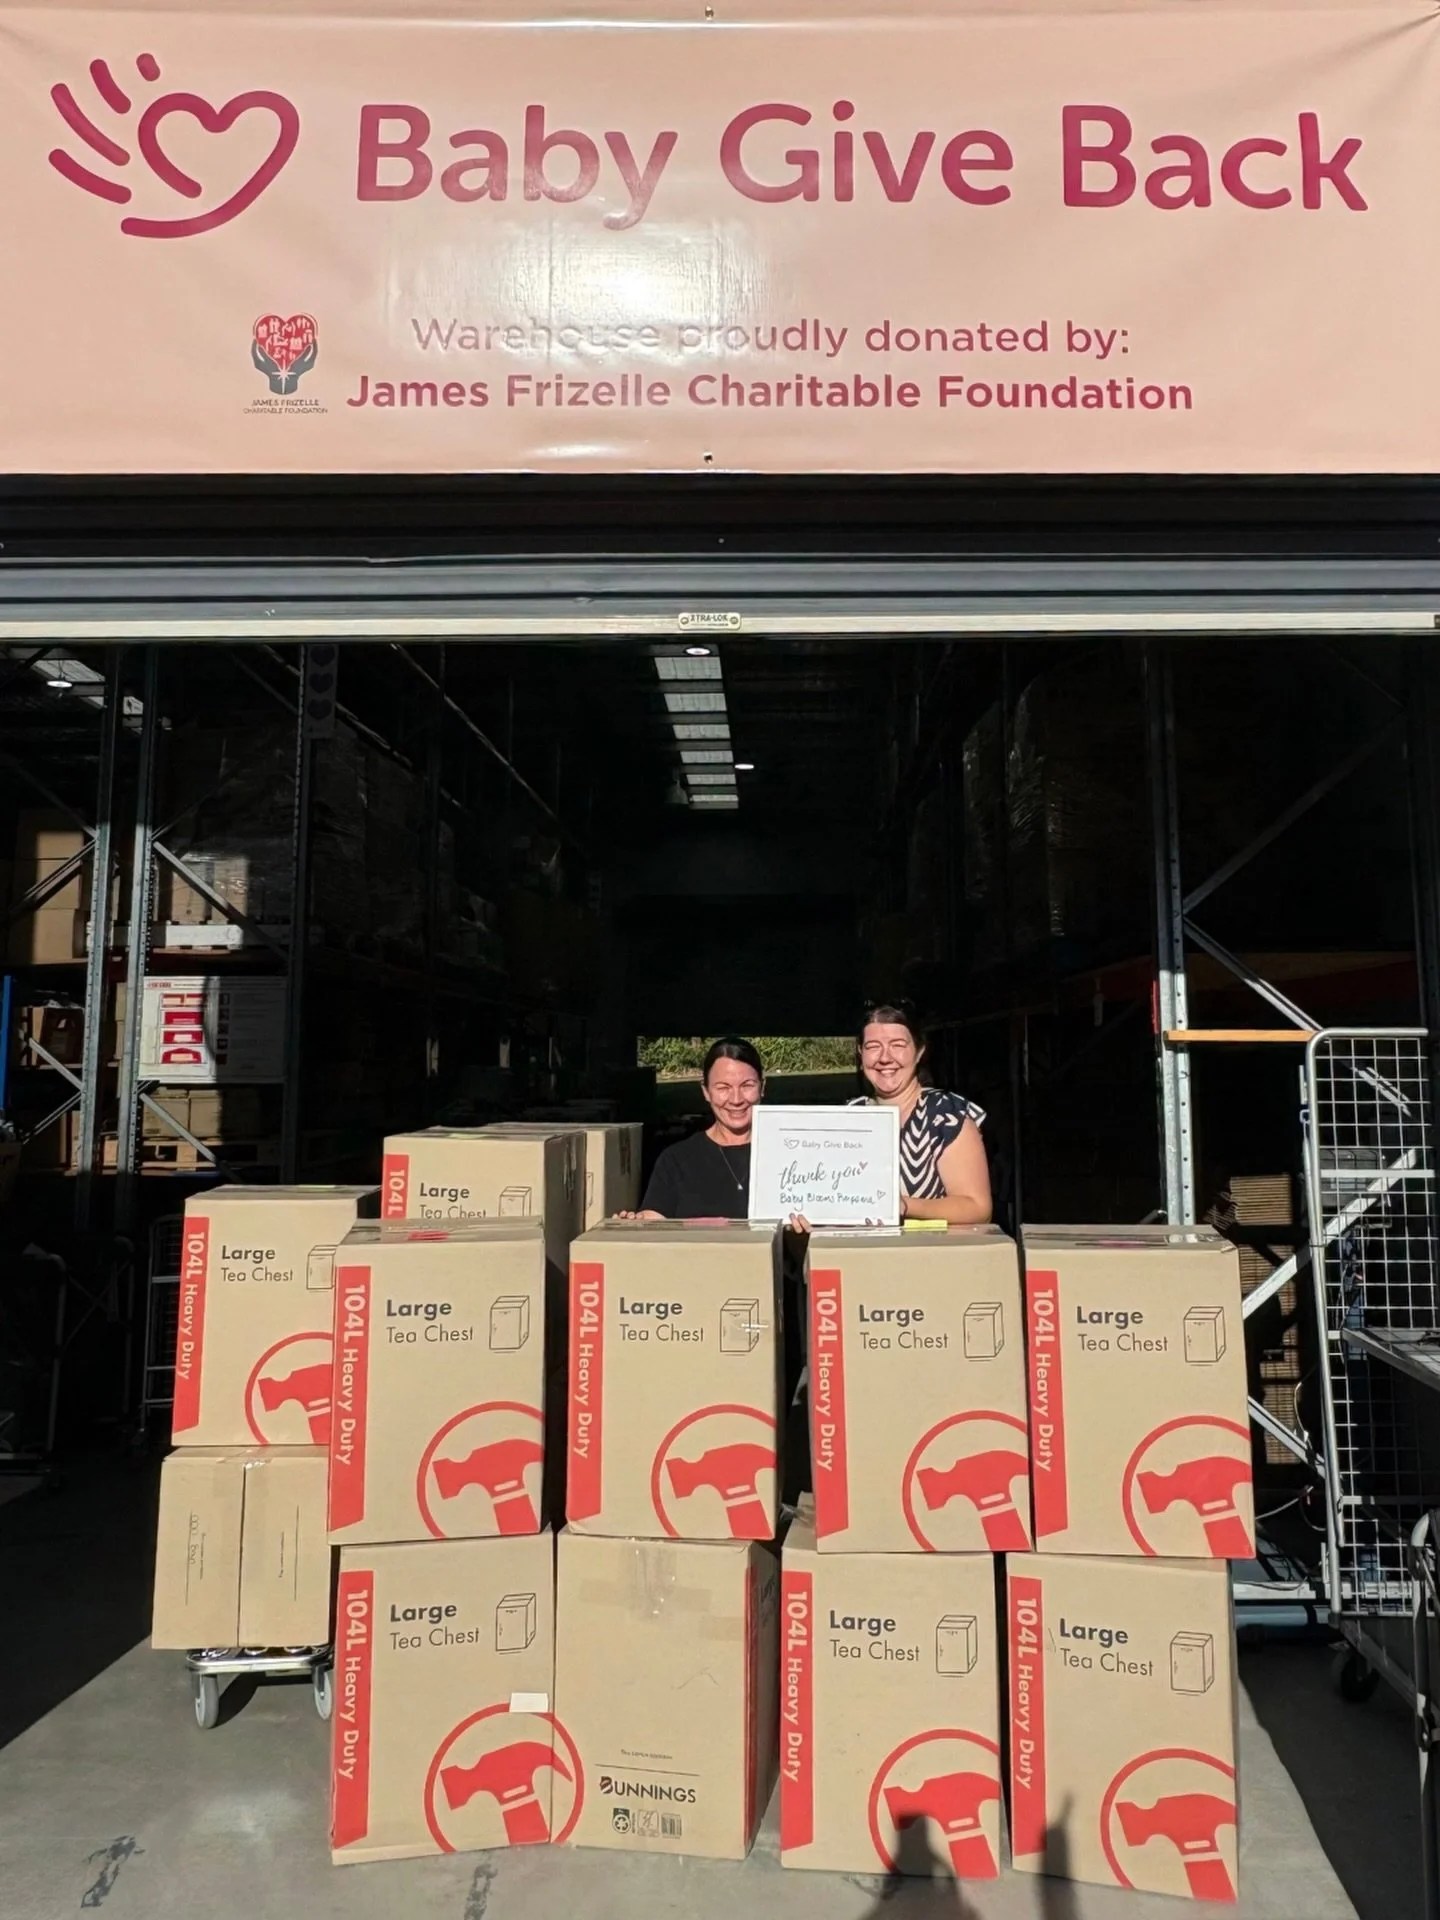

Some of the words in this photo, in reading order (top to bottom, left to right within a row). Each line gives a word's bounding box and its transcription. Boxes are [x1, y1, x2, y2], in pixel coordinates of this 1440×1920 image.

[357, 104, 678, 231] Baby
[720, 100, 1014, 205] Give
[1062, 104, 1368, 211] Back
[411, 317, 661, 351] Warehouse
[678, 318, 848, 358] proudly
[865, 319, 1048, 354] donated
[1065, 320, 1130, 360] by:
[347, 374, 489, 408] James
[506, 373, 671, 408] Frizelle
[688, 373, 921, 408] Charitable
[938, 374, 1193, 410] Foundation
[387, 1169, 405, 1216] 104L
[420, 1182, 470, 1202] Large
[778, 1160, 827, 1190] thank
[831, 1166, 862, 1190] you
[419, 1204, 442, 1219] Tea
[779, 1191, 804, 1212] Baby
[186, 1232, 205, 1279] 104L
[221, 1245, 276, 1264] Large
[221, 1267, 247, 1282] Tea
[251, 1266, 294, 1282] Chest
[180, 1284, 198, 1336] Heavy
[343, 1284, 366, 1343] 104L
[386, 1299, 452, 1321] Large
[579, 1281, 599, 1338] 104L
[619, 1297, 683, 1319] Large
[816, 1288, 838, 1347] 104L
[859, 1304, 924, 1327] Large
[1033, 1289, 1055, 1347] 104L
[1076, 1306, 1144, 1329] Large
[386, 1326, 417, 1343] Tea
[424, 1324, 473, 1343] Chest
[619, 1323, 649, 1341] Tea
[656, 1323, 704, 1342] Chest
[859, 1331, 891, 1349] Tea
[898, 1330, 949, 1349] Chest
[1077, 1333, 1110, 1351] Tea
[1116, 1332, 1168, 1352] Chest
[176, 1341, 195, 1380] Duty
[337, 1348, 359, 1412] Heavy
[574, 1343, 594, 1406] Heavy
[815, 1353, 834, 1417] Heavy
[1033, 1353, 1052, 1418] Heavy
[335, 1418, 356, 1465] Duty
[573, 1412, 592, 1459] Duty
[816, 1423, 836, 1472] Duty
[1035, 1424, 1054, 1472] Duty
[346, 1589, 368, 1652] 104L
[390, 1604, 457, 1625] Large
[786, 1591, 808, 1652] 104L
[829, 1609, 896, 1636] Large
[1016, 1598, 1038, 1659] 104L
[1059, 1617, 1129, 1648] Large
[390, 1631, 422, 1651] Tea
[428, 1626, 480, 1647] Chest
[829, 1639, 862, 1659] Tea
[868, 1639, 920, 1662] Chest
[1060, 1647, 1093, 1670] Tea
[1100, 1651, 1154, 1677] Chest
[339, 1656, 361, 1724] Heavy
[784, 1657, 803, 1726] Heavy
[1014, 1663, 1033, 1733] Heavy
[338, 1729, 359, 1779] Duty
[784, 1732, 803, 1784] Duty
[1015, 1739, 1035, 1790] Duty
[600, 1775, 697, 1804] BUNNINGS
